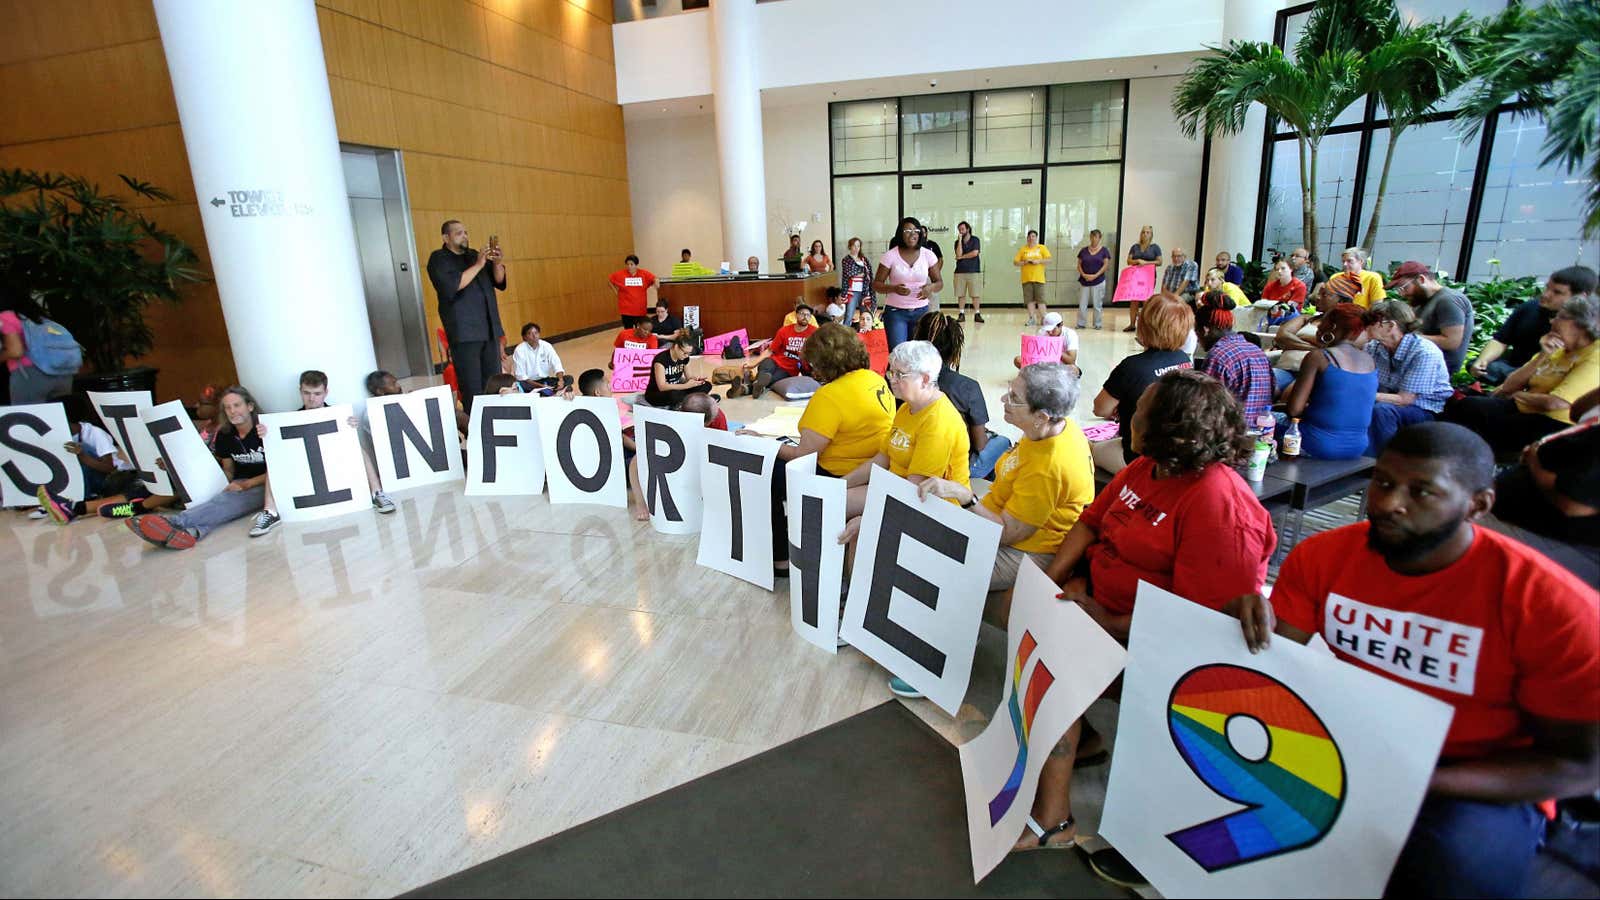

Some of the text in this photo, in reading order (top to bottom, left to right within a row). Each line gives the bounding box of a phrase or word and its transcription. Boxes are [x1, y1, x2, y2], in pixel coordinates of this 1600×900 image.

[0, 412, 70, 498] S
[280, 419, 353, 510] I
[385, 397, 450, 480] N
[481, 406, 532, 483] F
[556, 408, 612, 493] O
[645, 421, 686, 522] R
[707, 444, 765, 563] T
[862, 494, 970, 679] E
[1332, 603, 1471, 658] UNITE
[1335, 628, 1460, 684] HERE!
[1165, 662, 1348, 874] 9
